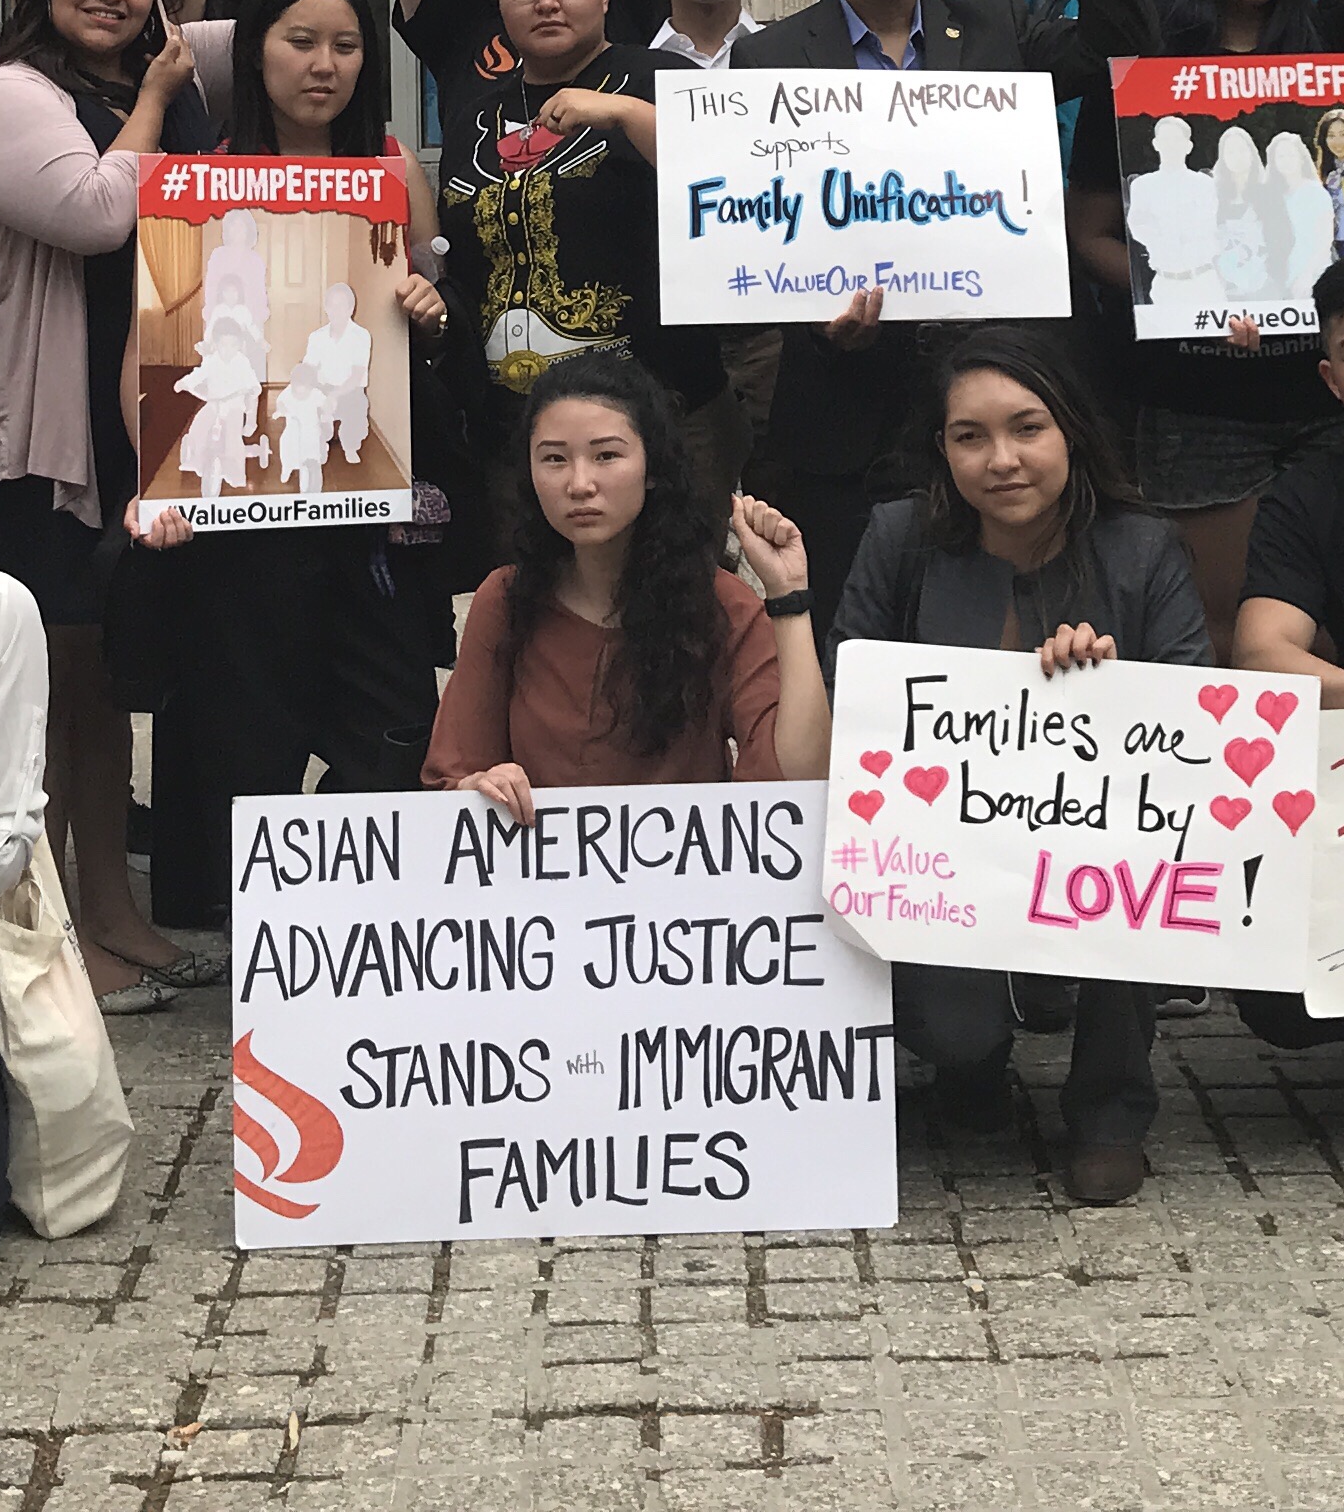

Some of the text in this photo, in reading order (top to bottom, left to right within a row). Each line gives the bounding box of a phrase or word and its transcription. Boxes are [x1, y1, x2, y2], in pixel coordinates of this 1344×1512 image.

[674, 81, 1018, 128] THIS ASIAN AMERICAN
[750, 131, 851, 171] supports
[687, 175, 804, 246] Family
[168, 496, 391, 526] ValueOurFamilies
[902, 673, 1212, 765] Families are
[238, 799, 804, 894] ASIAN AMERICANS
[959, 760, 1196, 862] bonded by
[830, 835, 956, 881] #Value
[240, 913, 826, 1004] ADVANCING JUSTICE
[339, 1037, 552, 1110] STANDS
[617, 1023, 894, 1112] IMMIGRANT
[457, 1129, 752, 1225] FAMILIES
